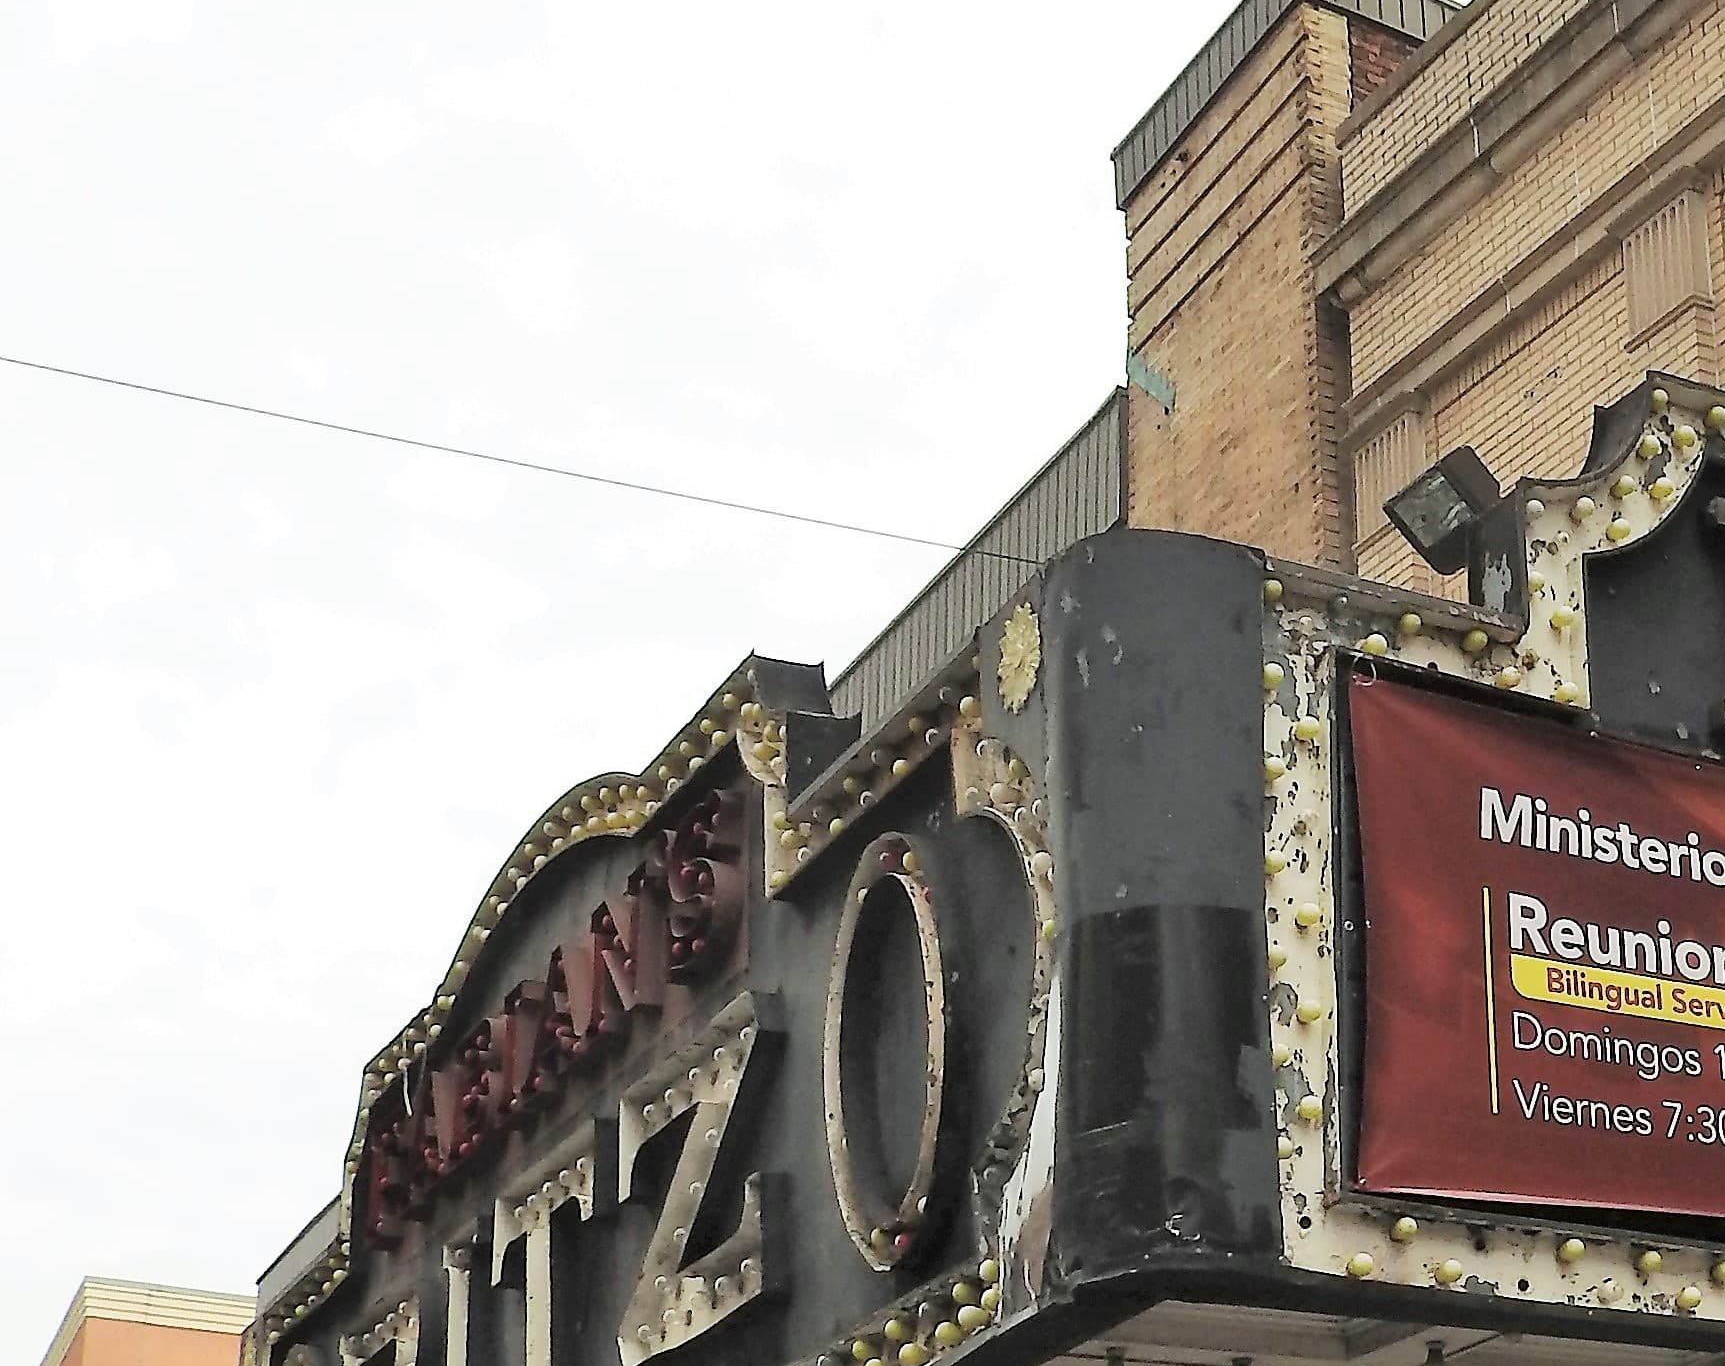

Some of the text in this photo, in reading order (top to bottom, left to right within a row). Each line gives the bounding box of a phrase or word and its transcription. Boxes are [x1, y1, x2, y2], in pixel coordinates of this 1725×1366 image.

[1545, 967, 1663, 1012] Bilingual
[1511, 1011, 1702, 1080] Domingos
[1512, 1079, 1653, 1136] Viernes
